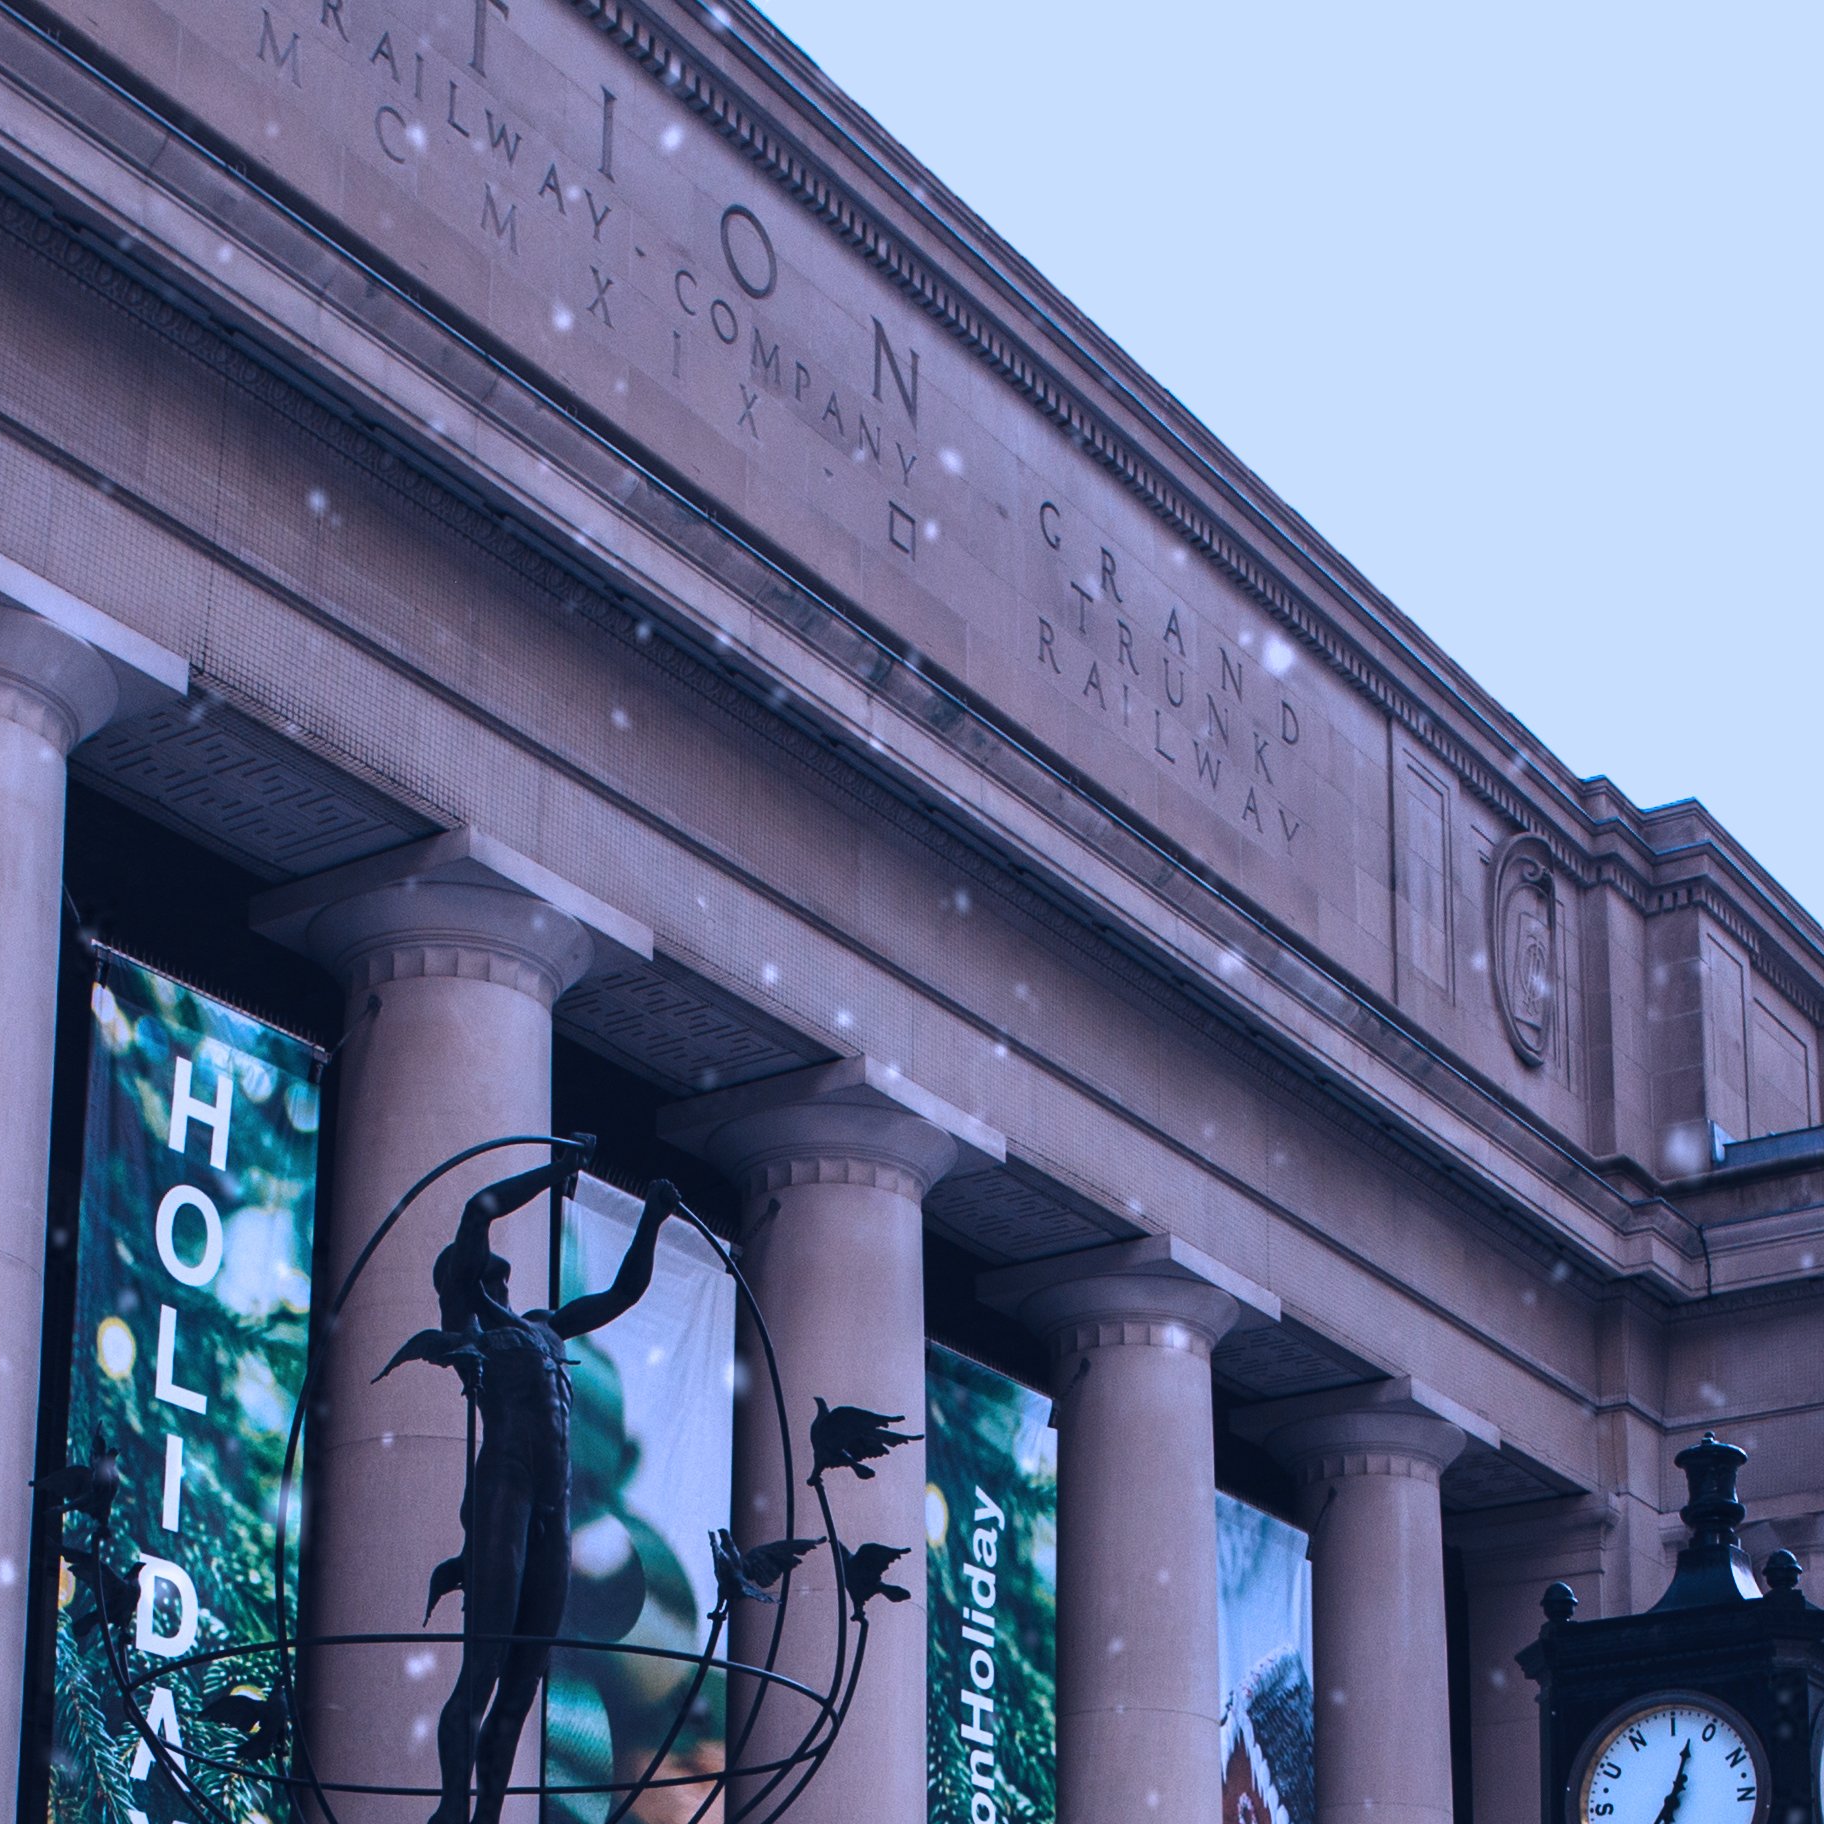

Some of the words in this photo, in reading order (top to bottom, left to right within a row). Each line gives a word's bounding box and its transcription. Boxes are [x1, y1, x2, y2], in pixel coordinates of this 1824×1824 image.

[675, 269, 918, 488] COMPANY
[1039, 500, 1300, 746] GRAND
[1069, 580, 1273, 786] TRUNK
[1037, 615, 1301, 857] RAILWAY
[1602, 1716, 1747, 1780] UNION
